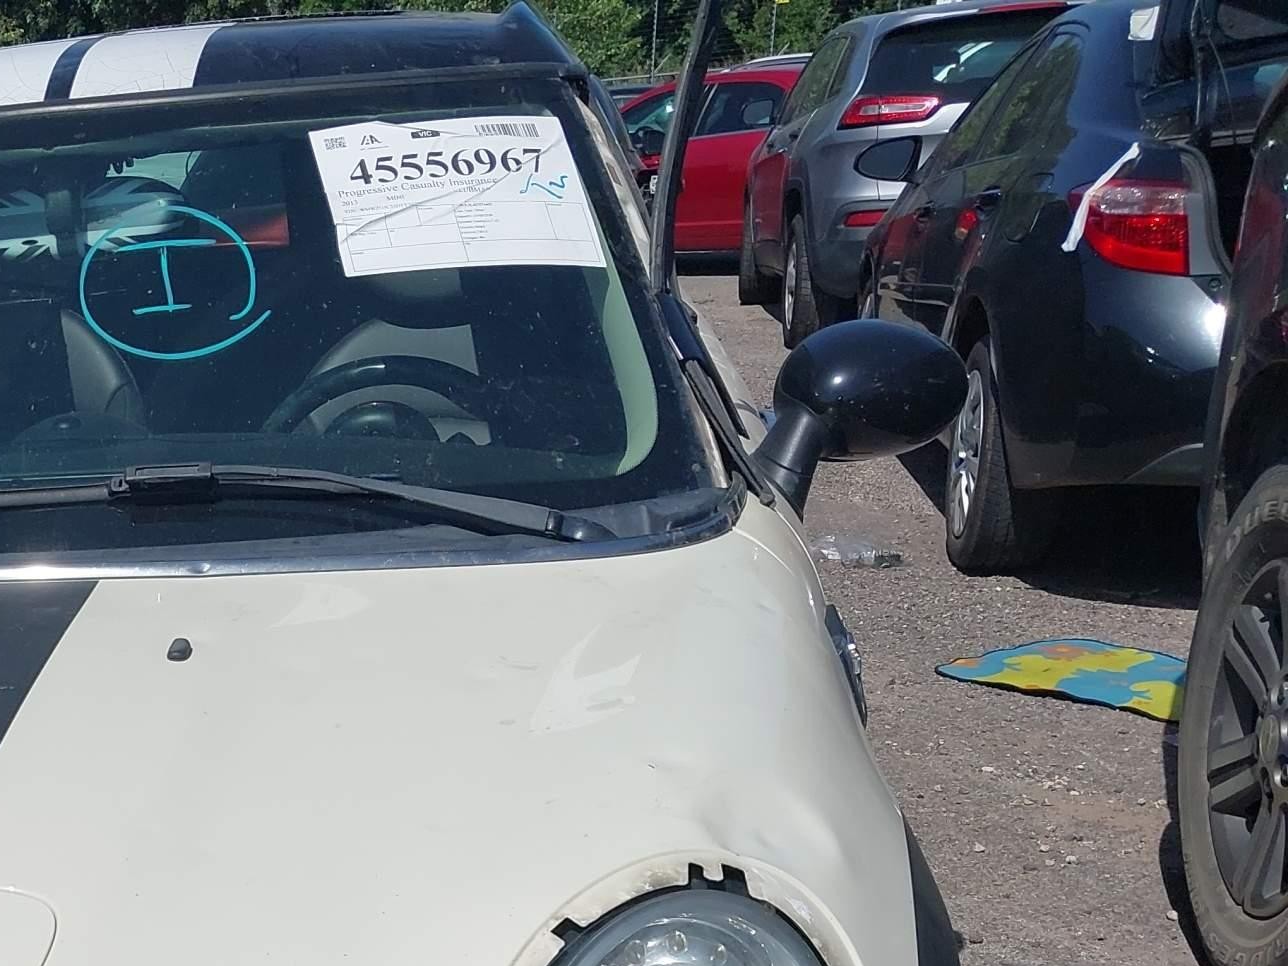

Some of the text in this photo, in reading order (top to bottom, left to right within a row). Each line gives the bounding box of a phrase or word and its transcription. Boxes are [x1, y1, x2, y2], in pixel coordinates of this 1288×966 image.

[350, 147, 542, 185] 45556967
[338, 184, 398, 198] Progressive
[400, 179, 445, 191] Casualty
[449, 177, 498, 187] Insurance
